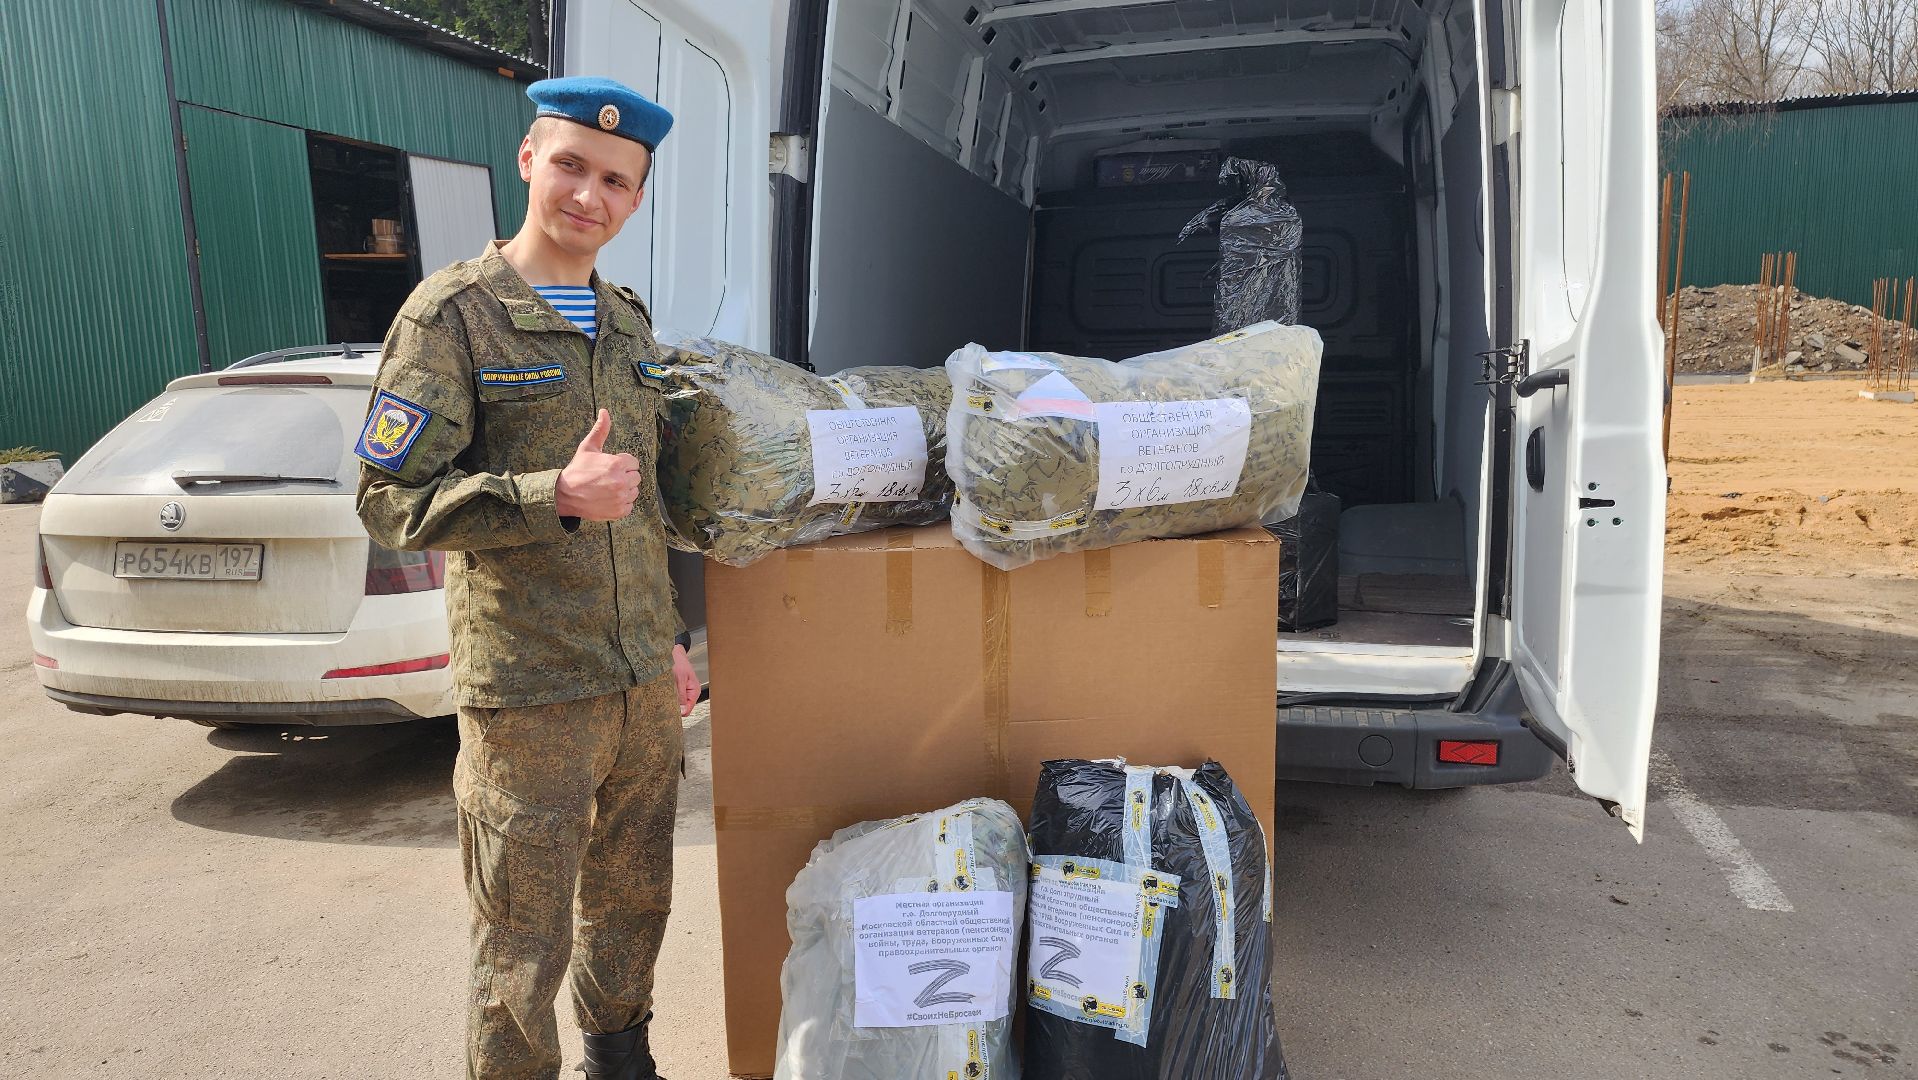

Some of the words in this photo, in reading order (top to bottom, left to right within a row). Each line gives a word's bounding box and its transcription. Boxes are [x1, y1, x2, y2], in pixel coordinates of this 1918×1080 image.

[483, 373, 524, 381] ВООРУЖЕННЫЕ
[525, 371, 540, 380] СИЛЫ
[540, 369, 561, 379] РОССИИ
[1122, 409, 1212, 423] ОБЩЕСТВЕННАЯ
[1131, 424, 1212, 439] ОРГАНИЗАЦИЯ
[836, 431, 898, 445] ОРГАНИЗАЦИЯ
[844, 448, 893, 460] ВЕТЕРАНОВ
[1138, 443, 1199, 456] ВЕТЕРАНОВ
[847, 459, 913, 477] ДОЛГОПРУДНЫЙ
[1136, 455, 1225, 475] ДОЛГОПРУДНЫЙ
[219, 547, 254, 568] 197
[225, 568, 243, 576] RUS
[919, 908, 979, 918] Долгопрудный
[1079, 903, 1134, 919] общественно
[861, 921, 913, 930] Московской
[915, 918, 958, 927] областной
[916, 927, 960, 937] ветеранов
[1105, 926, 1122, 936] Сил
[931, 936, 989, 946] Вооруженных
[1085, 934, 1119, 945] органов
[878, 946, 970, 957] правоохранительных
[1039, 936, 1083, 989] Z
[908, 958, 976, 1008] Z
[906, 1009, 982, 1021] #СвоихНеБросаем
